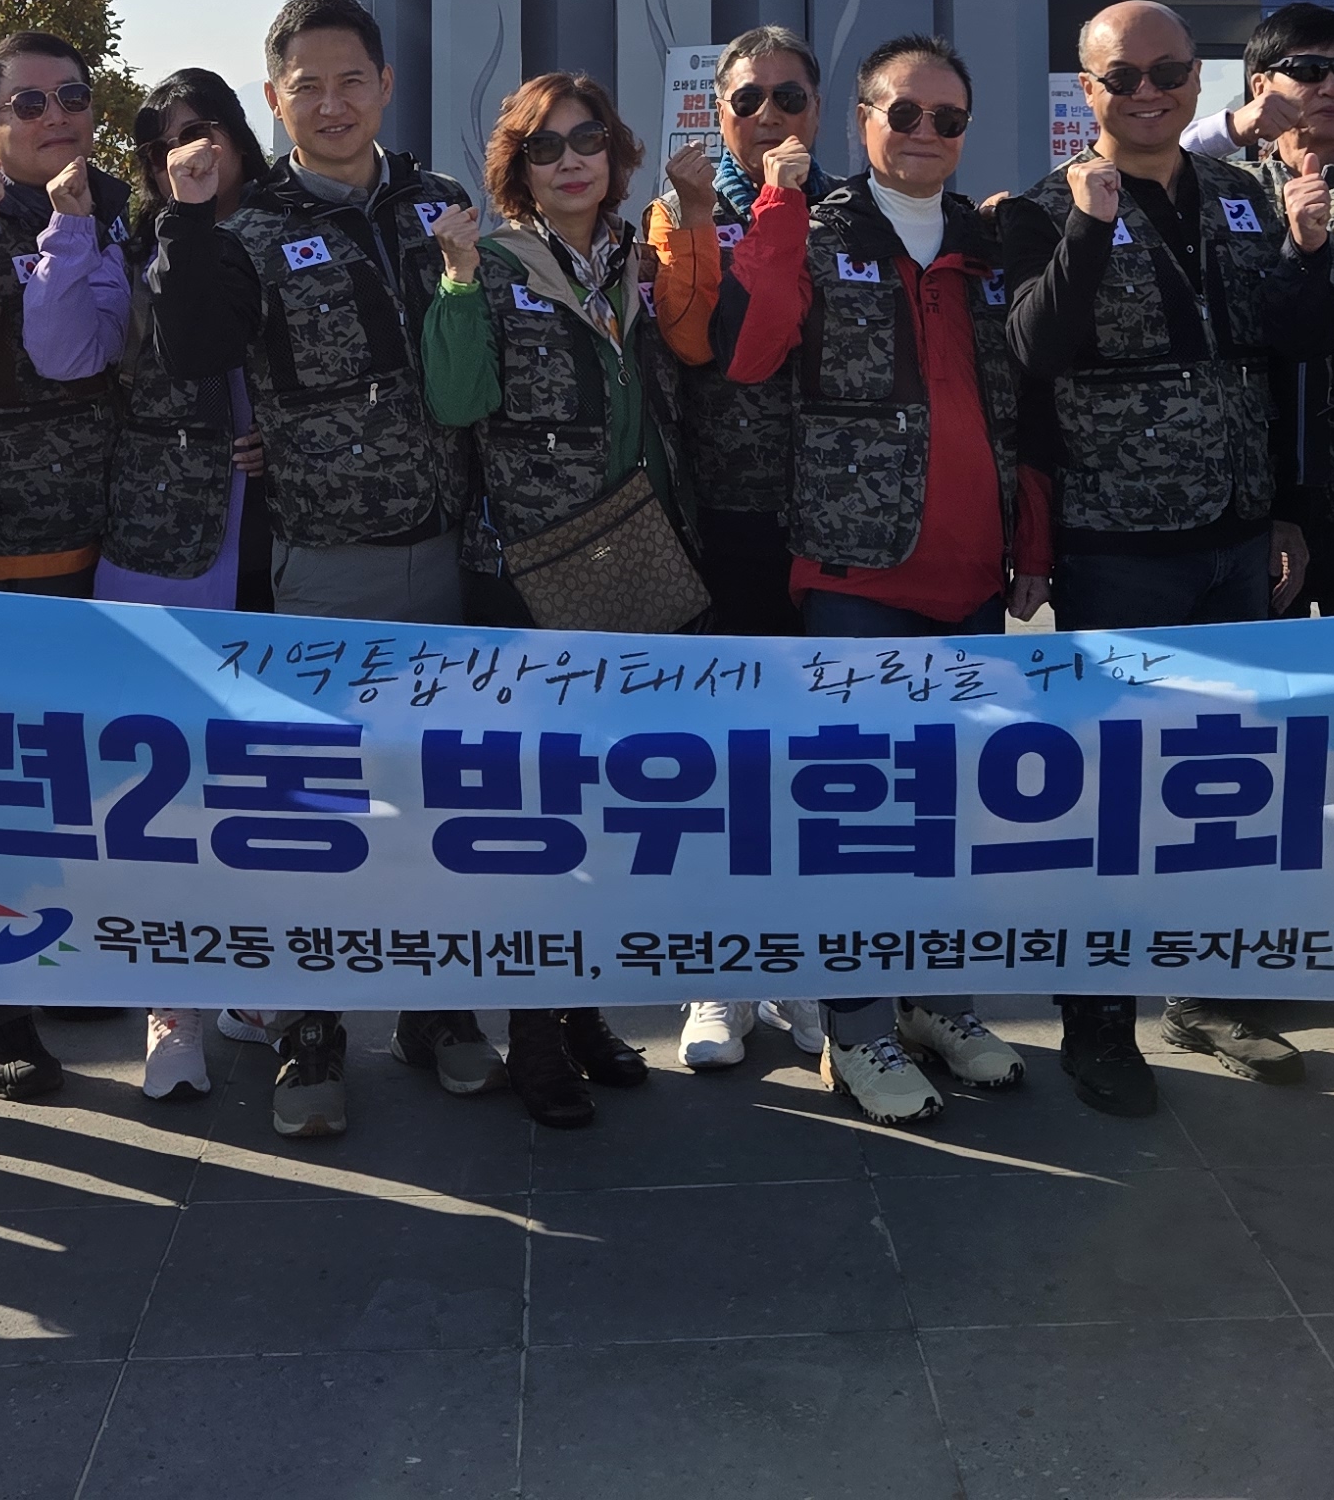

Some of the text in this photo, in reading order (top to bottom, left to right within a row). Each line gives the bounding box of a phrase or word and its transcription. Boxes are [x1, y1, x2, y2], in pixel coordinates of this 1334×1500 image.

[672, 79, 697, 91] 모바일
[683, 93, 706, 111] 할인
[676, 111, 711, 128] 기다림
[1054, 104, 1093, 118] 물 반입
[1051, 120, 1081, 136] 음식
[218, 637, 1174, 707] 지역통합방위태세 확립을 위한
[421, 712, 1330, 881] 방위협의회
[94, 916, 274, 971] 옥련2동
[286, 926, 601, 981] 행정복지센터,
[614, 928, 804, 974] 옥련2동
[817, 928, 1068, 974] 방위협의회
[1084, 929, 1131, 971] 및
